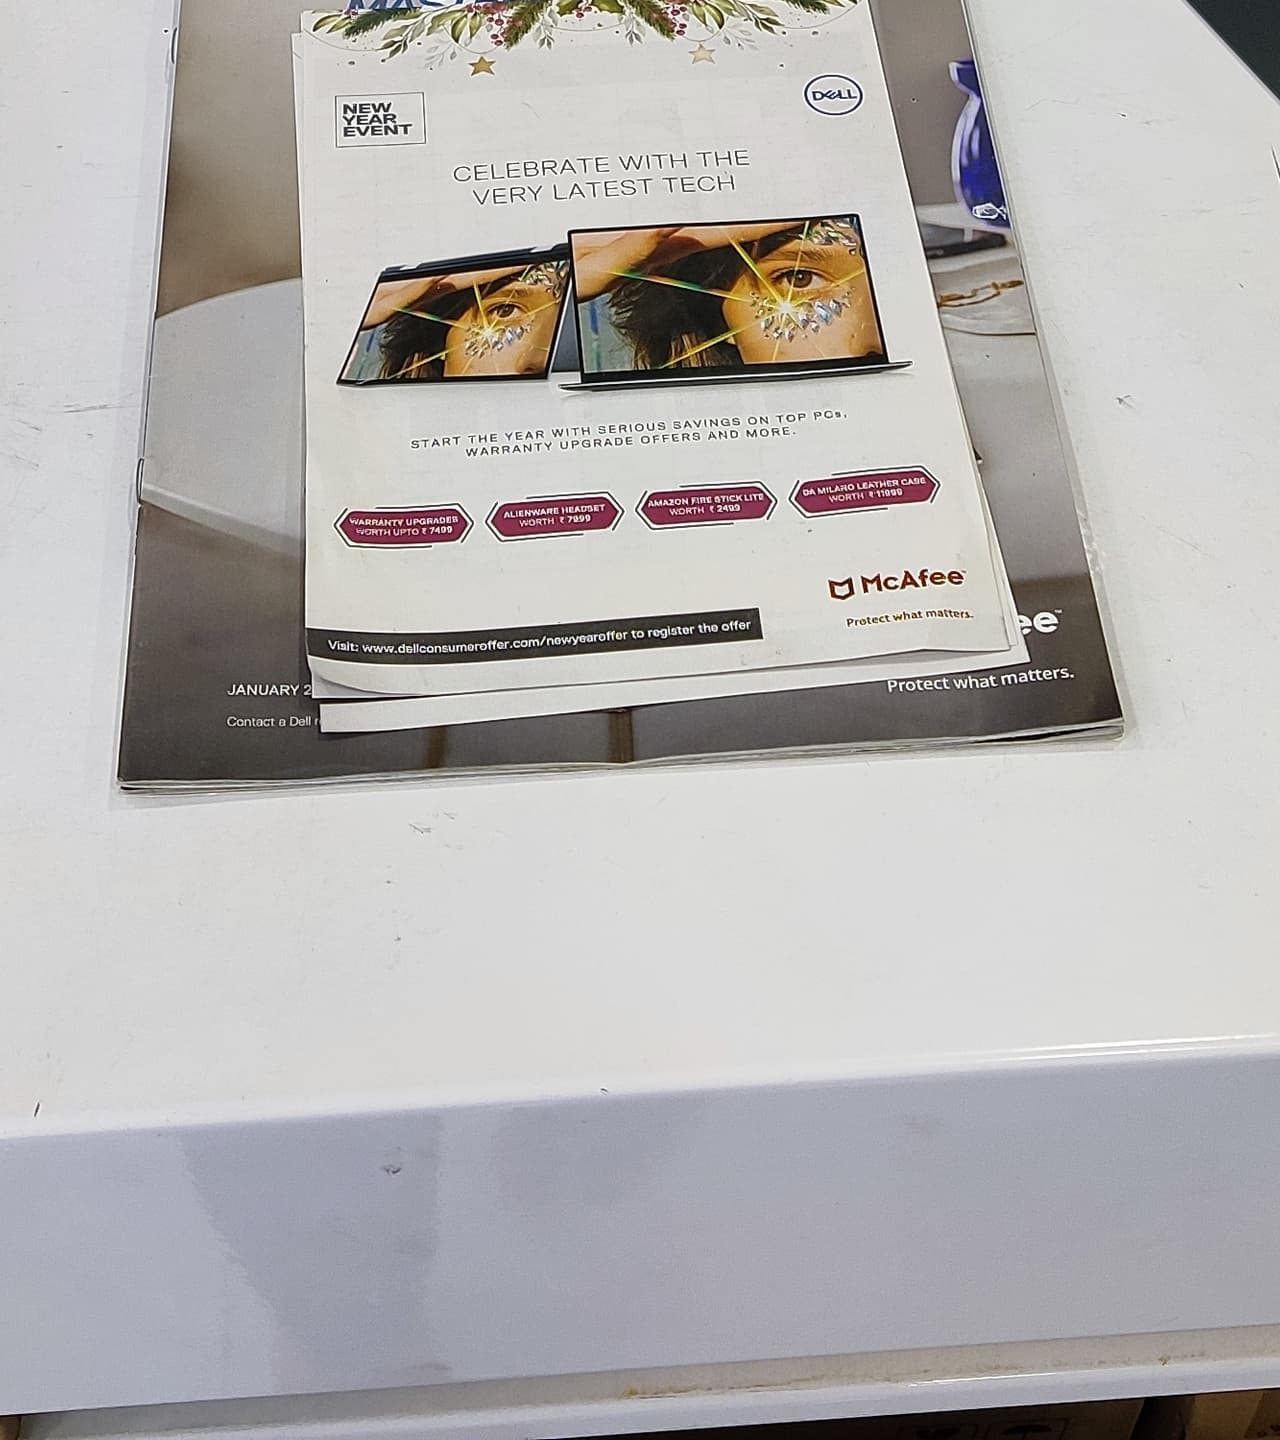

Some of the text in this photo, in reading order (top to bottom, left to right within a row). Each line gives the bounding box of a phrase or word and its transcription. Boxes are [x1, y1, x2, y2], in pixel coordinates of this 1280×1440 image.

[342, 101, 391, 114] NEW
[342, 112, 396, 125] YEAR
[343, 123, 412, 137] EVENT
[453, 149, 750, 181] CELEBRATE WITH THE
[472, 170, 734, 205] VERY LATEST TECH
[410, 435, 461, 448] START
[467, 433, 497, 444] THE
[504, 429, 544, 441] YEAR
[551, 426, 590, 437] WITH
[598, 421, 665, 434] SERIOUS
[672, 417, 740, 429] SAVINGS
[747, 415, 769, 425] ON
[775, 412, 806, 424] TOP
[465, 426, 795, 456] WARRANTY UPGRADE OFFERS AND MORE.
[846, 608, 974, 627] Protect what matters.
[327, 639, 358, 651] Visit:
[630, 629, 644, 639] to
[647, 625, 694, 638] register
[697, 622, 718, 633] the
[721, 620, 751, 631] offer
[226, 683, 300, 697] JANUARY
[887, 667, 1074, 692] Protect what matters.
[227, 715, 313, 728] Contact a Dell
